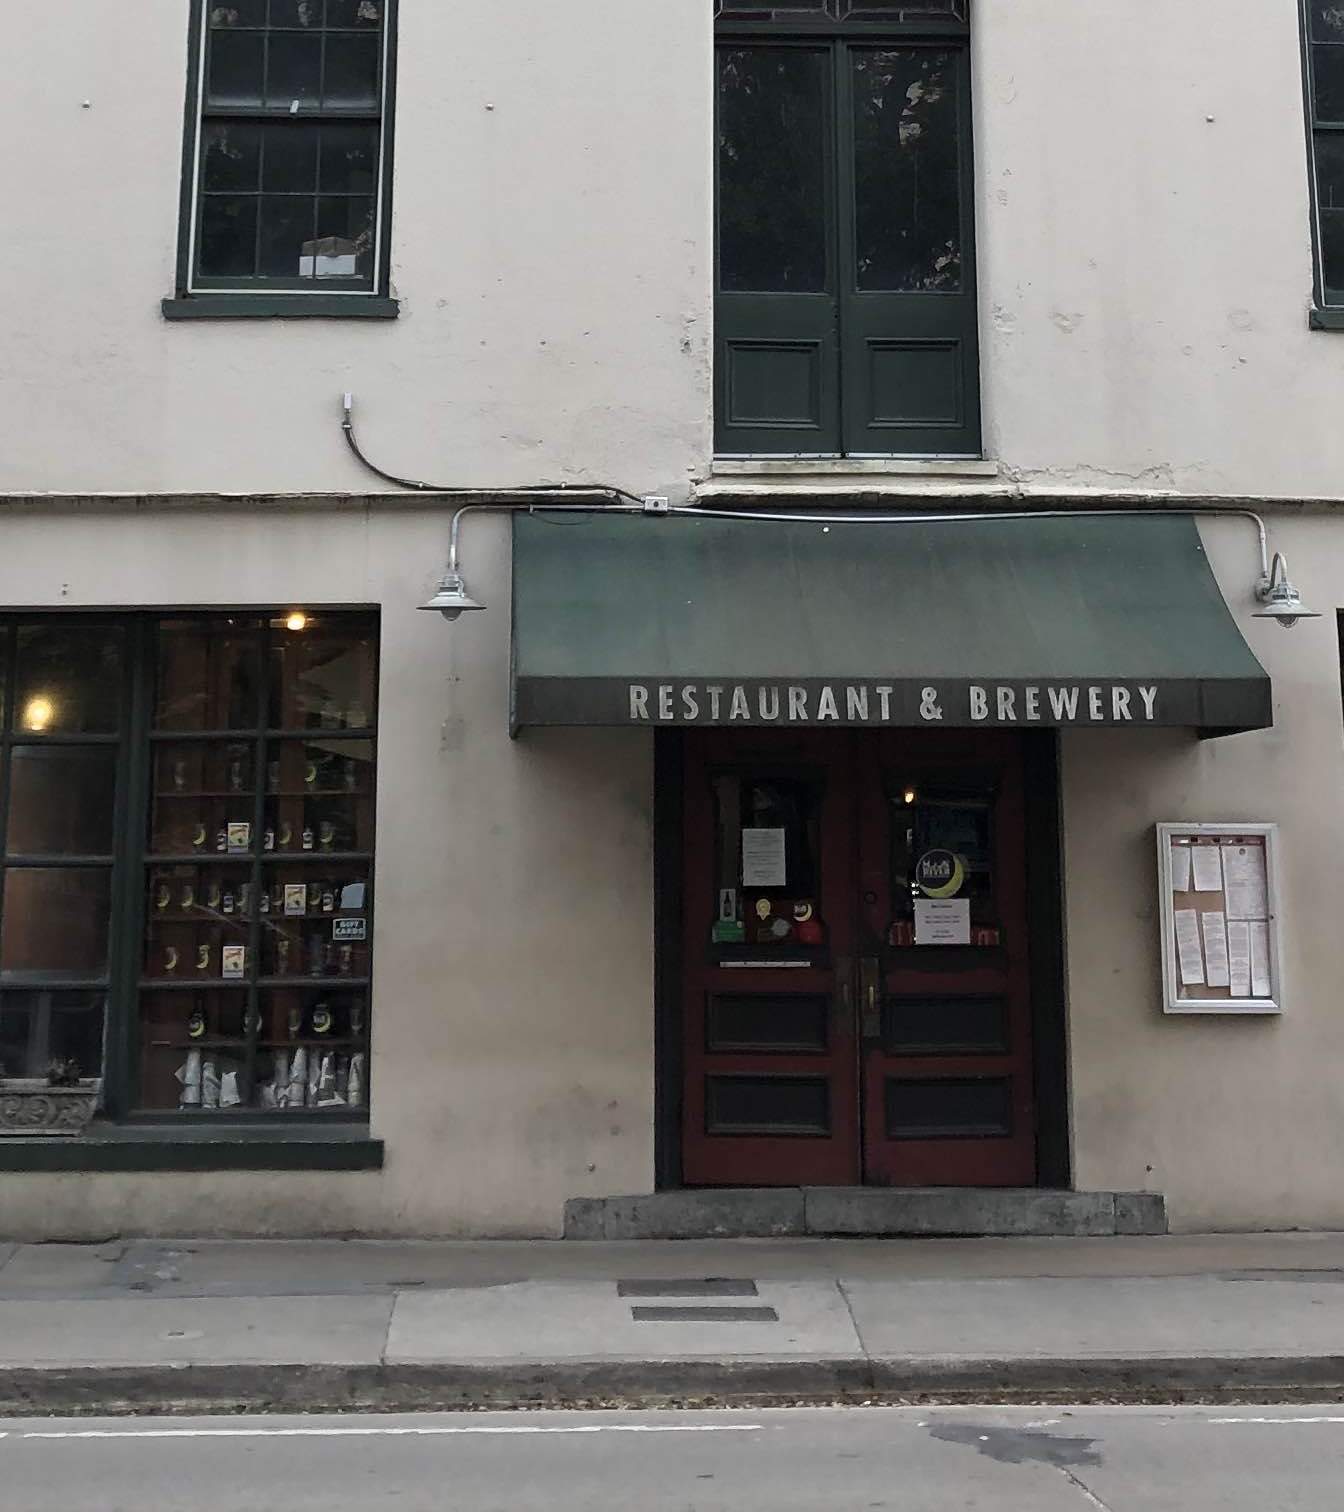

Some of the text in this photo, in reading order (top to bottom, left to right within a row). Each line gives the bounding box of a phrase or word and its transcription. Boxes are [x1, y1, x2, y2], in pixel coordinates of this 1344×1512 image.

[628, 684, 1159, 721] RESTAURANT & BREWERY
